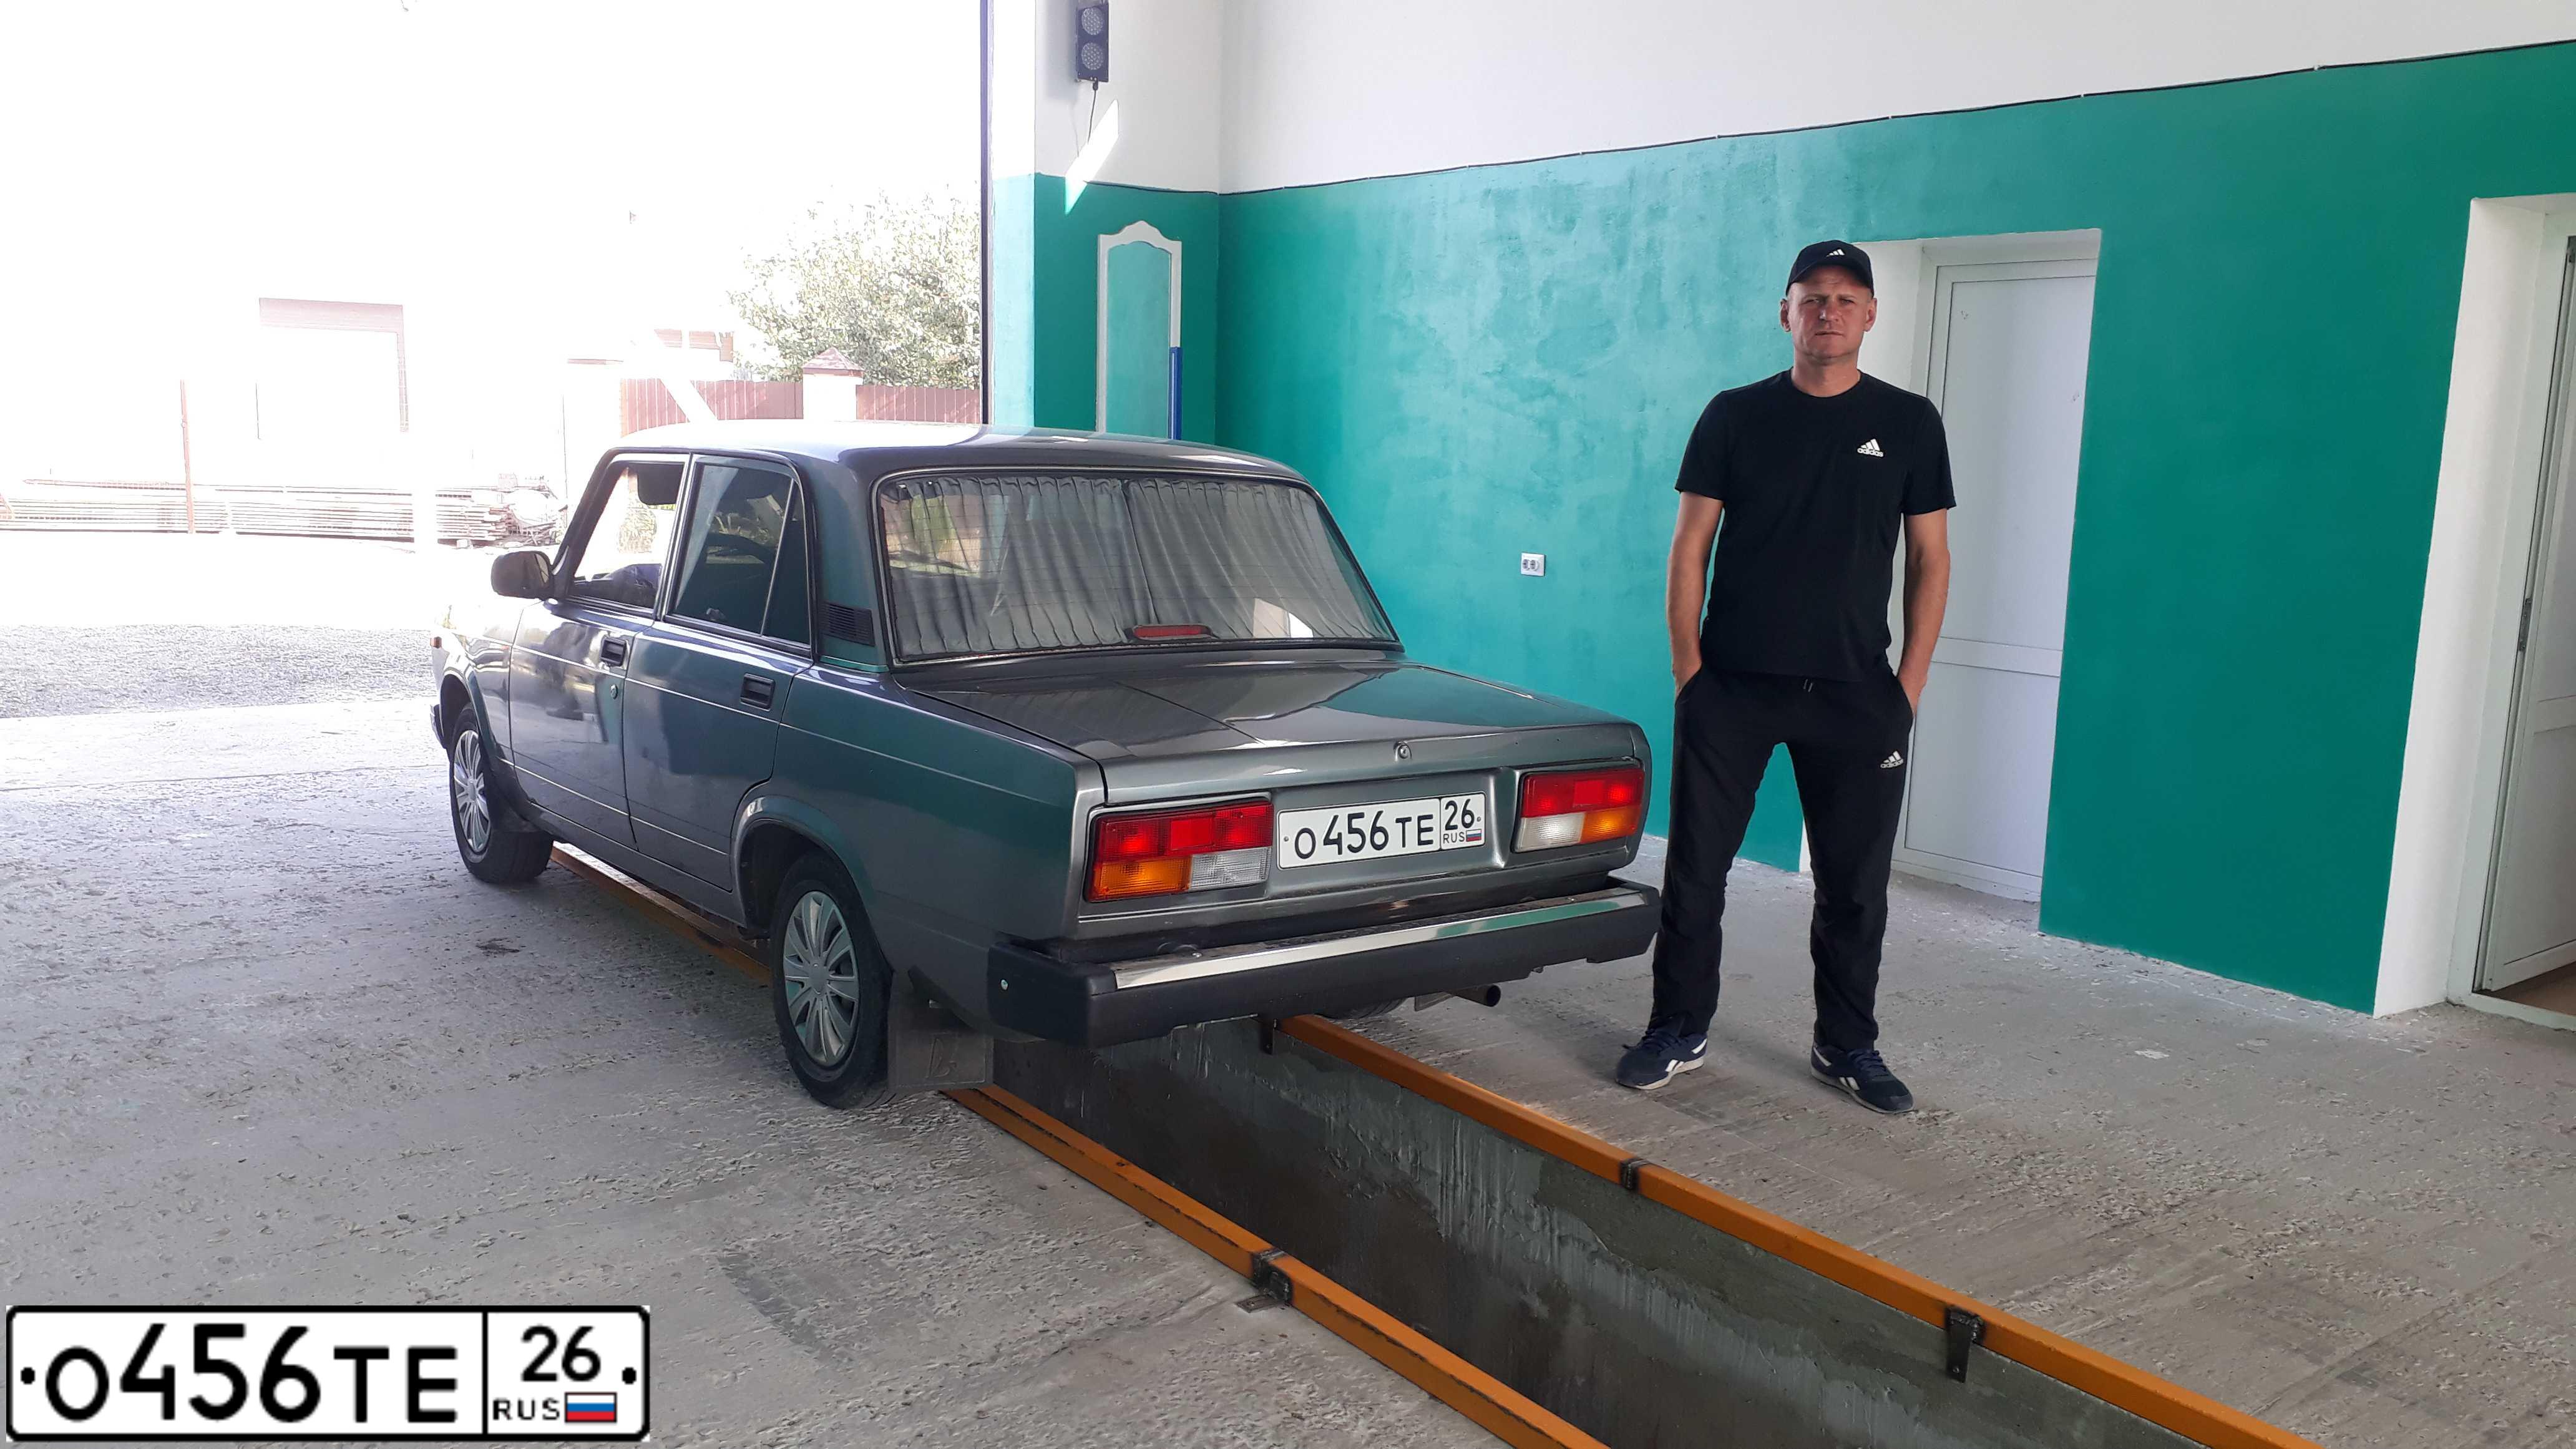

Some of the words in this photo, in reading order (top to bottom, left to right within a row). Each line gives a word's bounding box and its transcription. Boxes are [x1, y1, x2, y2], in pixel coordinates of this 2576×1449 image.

[1857, 447, 1883, 457] adidas
[1445, 798, 1475, 831] 26
[1443, 831, 1465, 845] RUS
